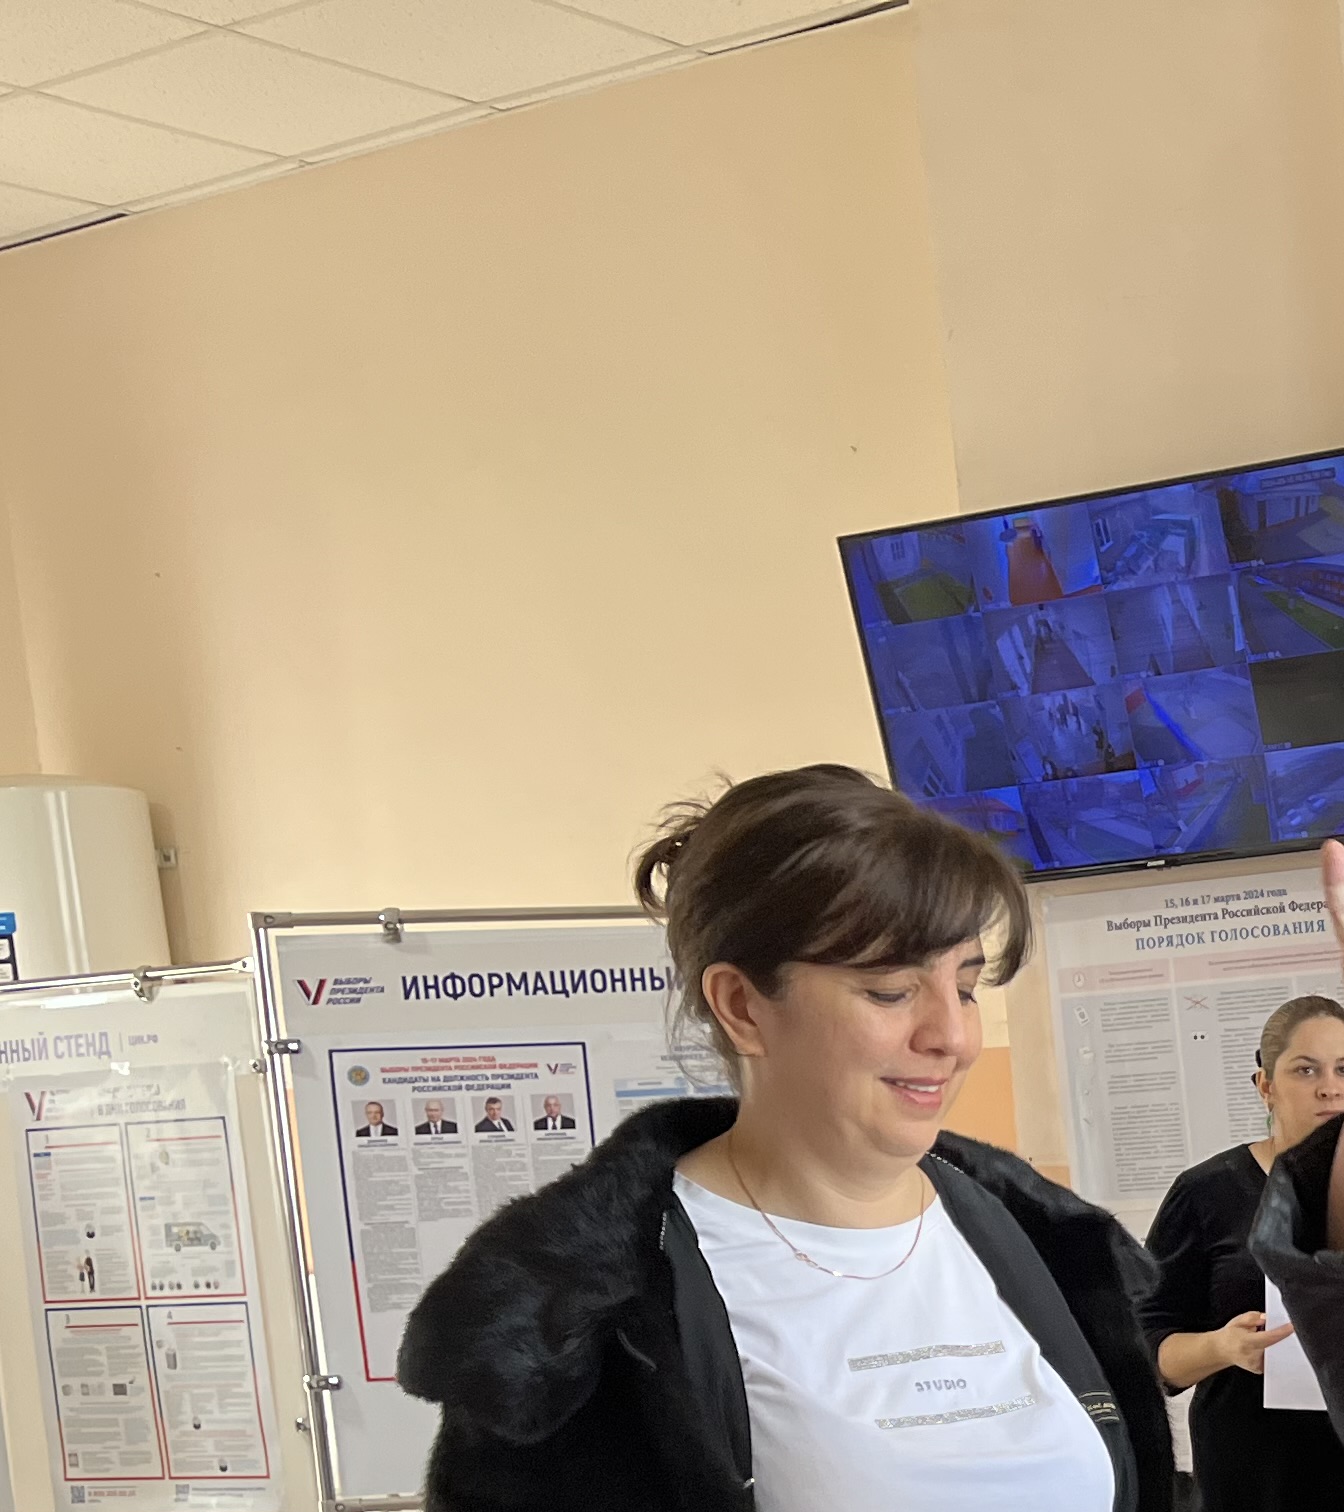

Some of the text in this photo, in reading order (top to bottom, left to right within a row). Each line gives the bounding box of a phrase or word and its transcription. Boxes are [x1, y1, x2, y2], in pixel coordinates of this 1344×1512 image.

[1213, 891, 1242, 906] марта
[1242, 888, 1266, 902] 2024
[1106, 897, 1330, 933] Выборы Президента Российской Федера
[1135, 919, 1327, 951] ПОРЯДОК ГОЛОСОВАНИЯ
[401, 966, 683, 1001] ИНФОРМАЦИОННЫ
[53, 1031, 112, 1060] СТЕНД
